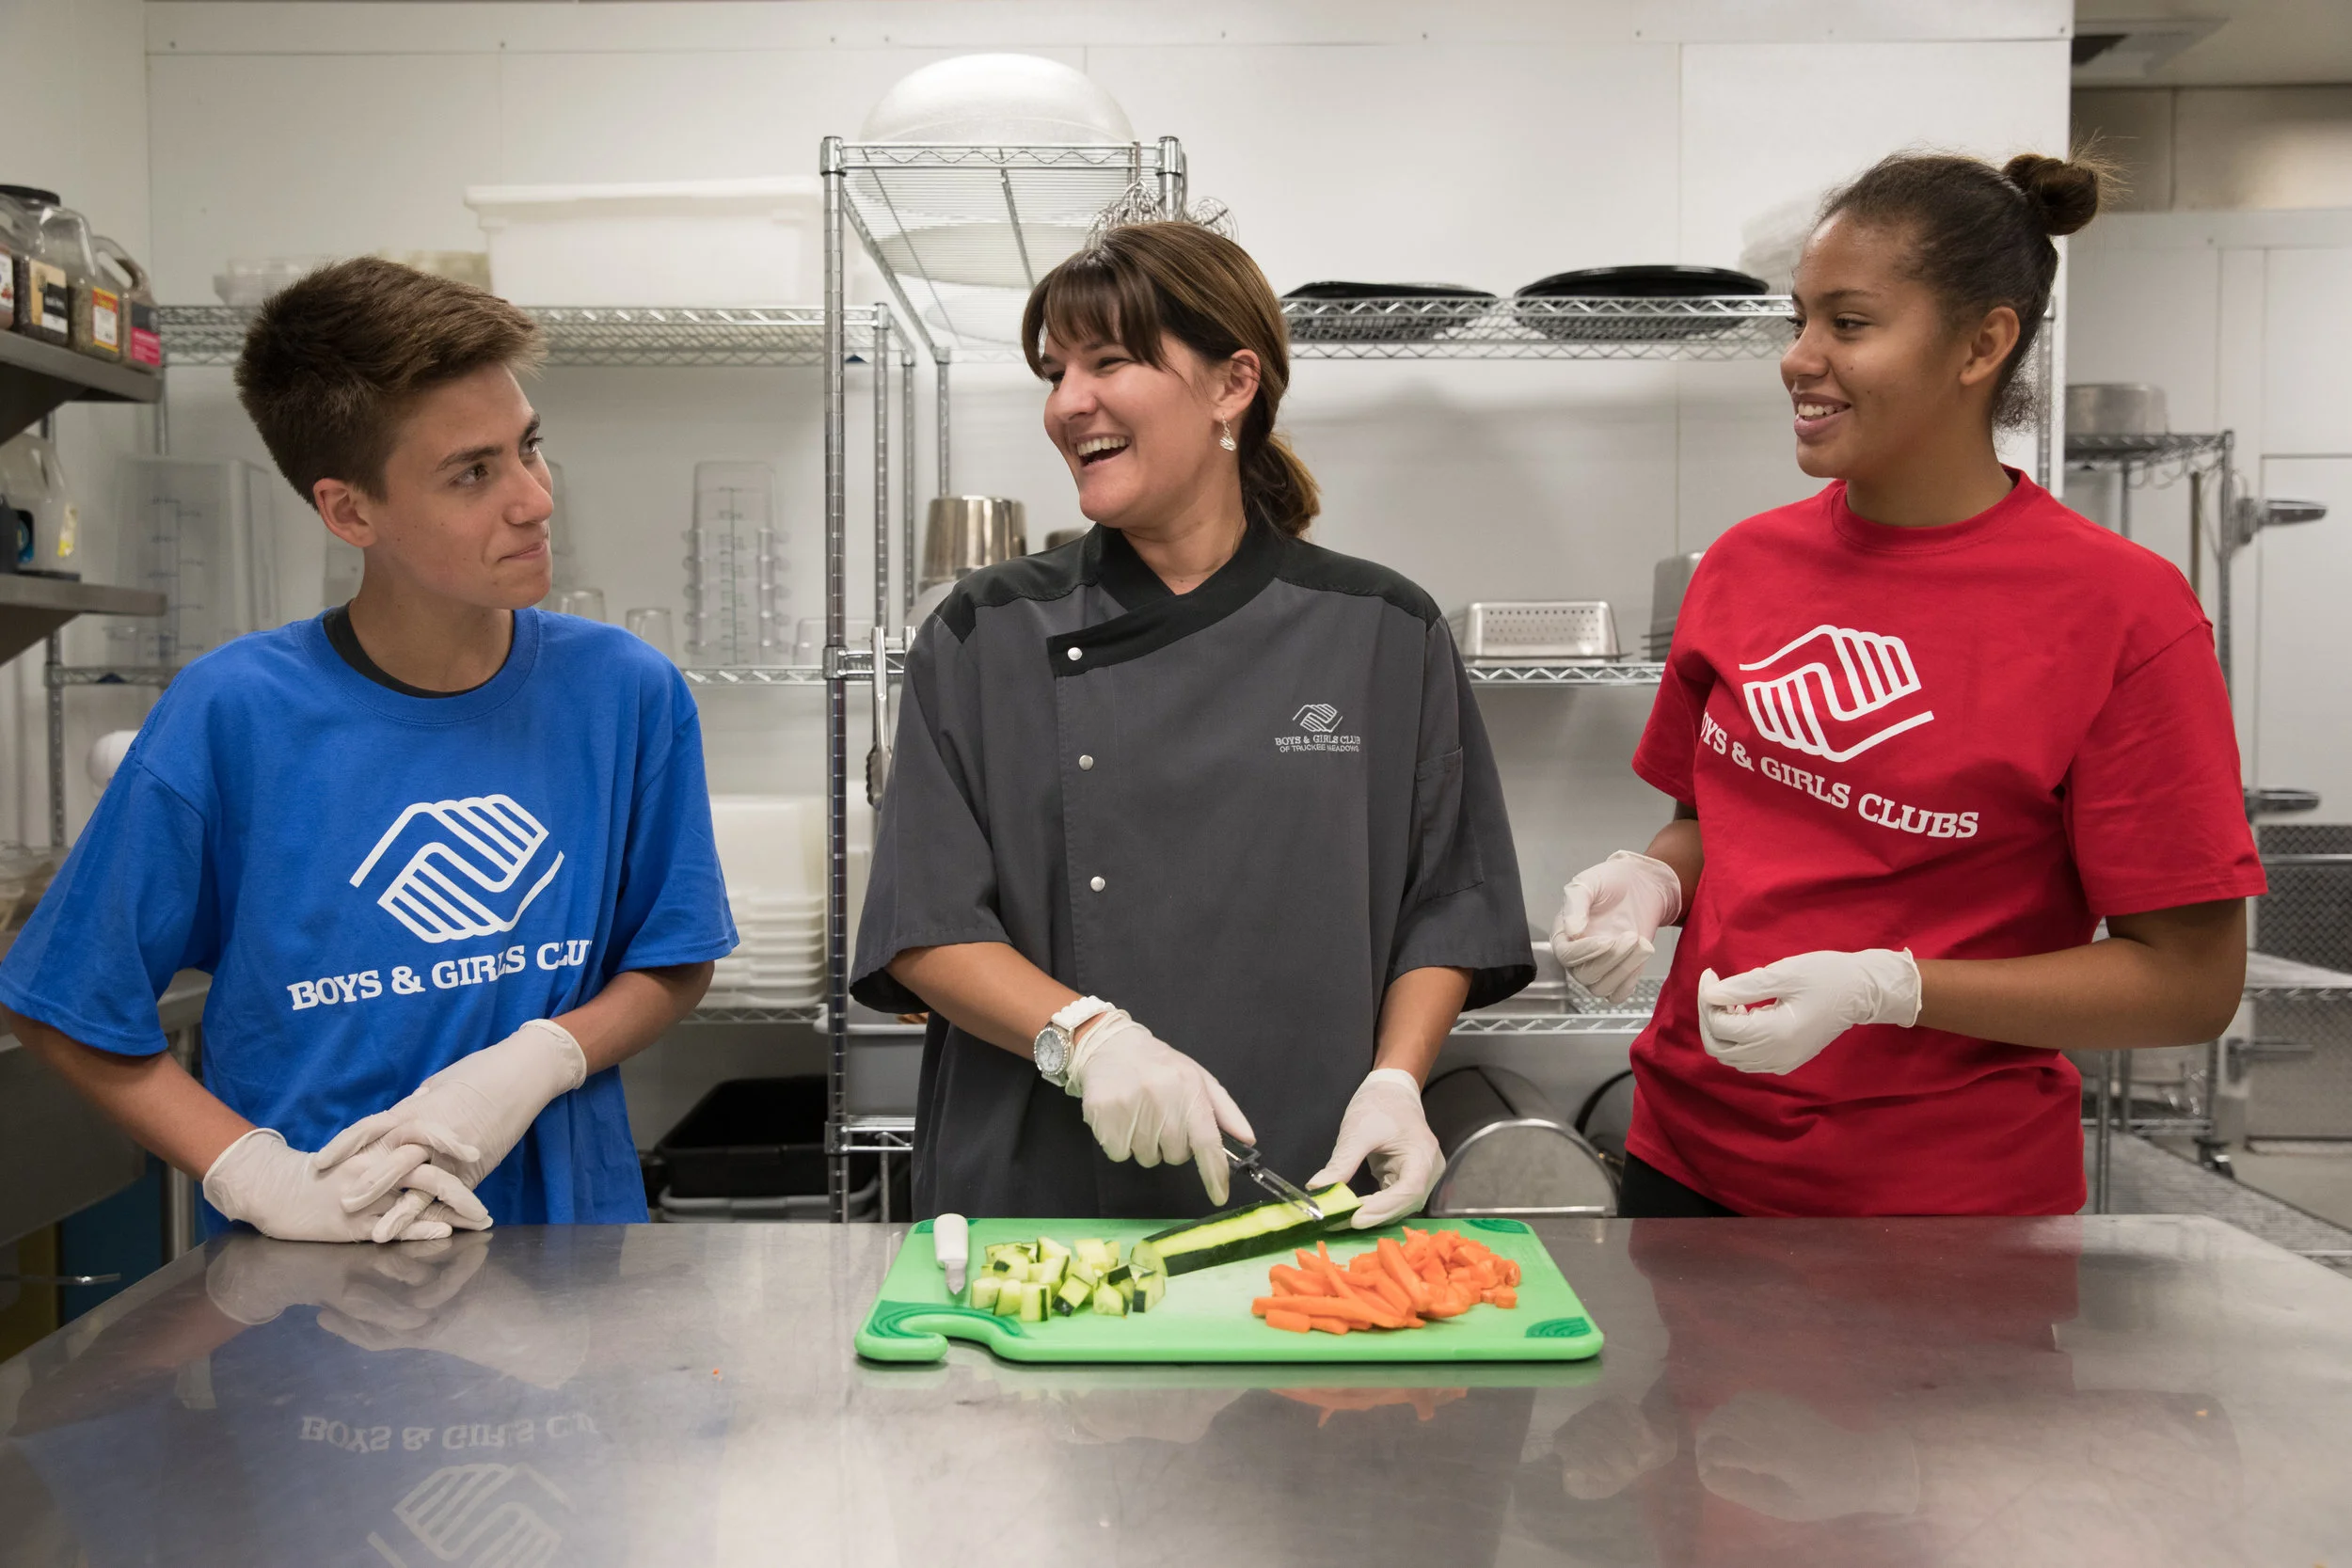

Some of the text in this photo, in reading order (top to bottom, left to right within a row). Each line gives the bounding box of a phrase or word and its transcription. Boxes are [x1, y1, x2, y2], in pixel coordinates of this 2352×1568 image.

[1275, 735, 1360, 746] BOYS & GIRLS CLUB
[1700, 707, 1979, 839] OYS & GIRLS CLUBS
[286, 970, 383, 1010] BOYS
[390, 965, 425, 994] &
[431, 944, 526, 990] GIRLS
